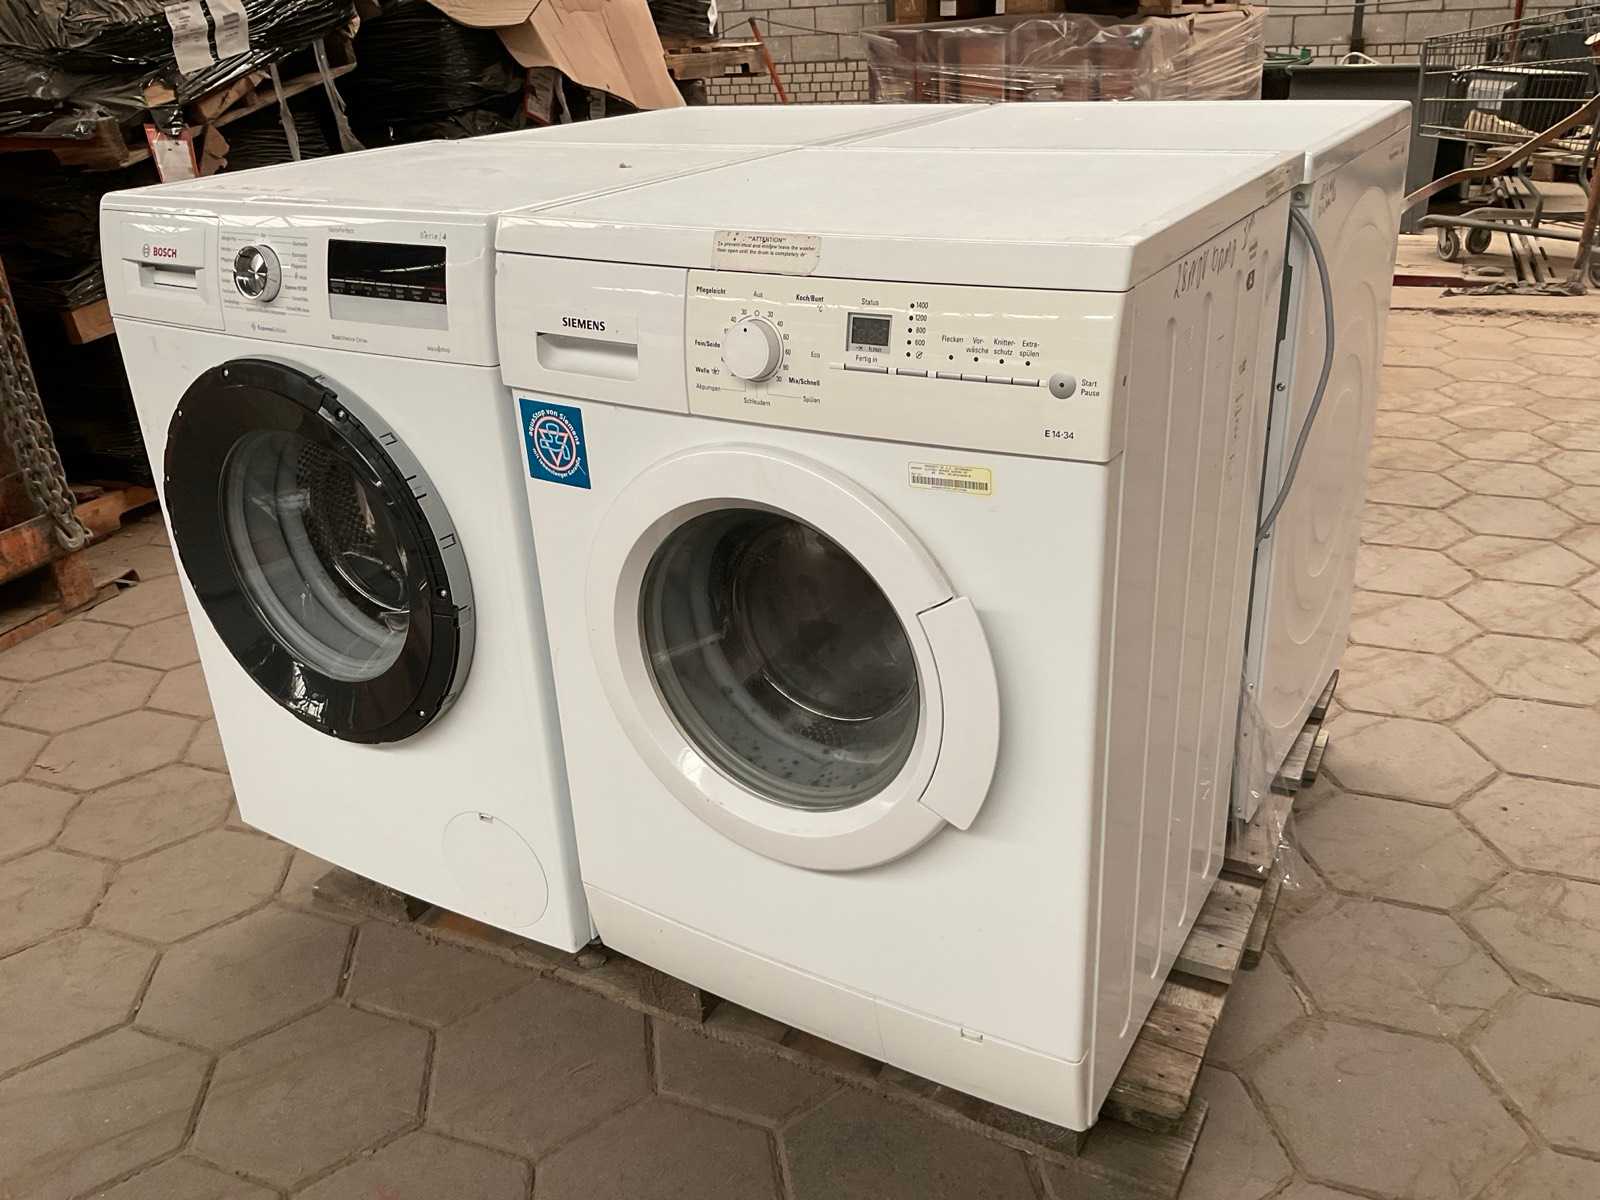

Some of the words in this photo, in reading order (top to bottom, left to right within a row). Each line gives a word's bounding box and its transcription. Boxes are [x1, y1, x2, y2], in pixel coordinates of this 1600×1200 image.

[153, 246, 177, 258] BOSCH
[696, 285, 726, 295] Pflegeleicht
[795, 293, 824, 303] Koch/Bunt
[861, 297, 880, 306] Status
[916, 301, 929, 310] 1400
[562, 316, 606, 331] SIEMENS
[915, 314, 928, 323] 1200
[776, 320, 784, 328] 40
[915, 327, 927, 335] 800
[914, 339, 926, 347] 600
[941, 334, 964, 344] Flecken
[972, 336, 985, 345] Vor-
[993, 337, 1016, 347] Knitter-
[1022, 339, 1040, 349] Extra-
[966, 346, 989, 355] wäsche
[993, 347, 1014, 356] schutz
[1019, 348, 1040, 359] spülen
[855, 354, 872, 364] Fertig
[872, 355, 878, 363] in
[788, 377, 821, 387] Mix/Schnell
[1081, 378, 1098, 388] Start
[1080, 388, 1100, 398] Pause
[545, 409, 559, 417] von
[559, 413, 580, 446] Siemens
[1044, 429, 1051, 438] E
[1052, 430, 1075, 440] 14-34
